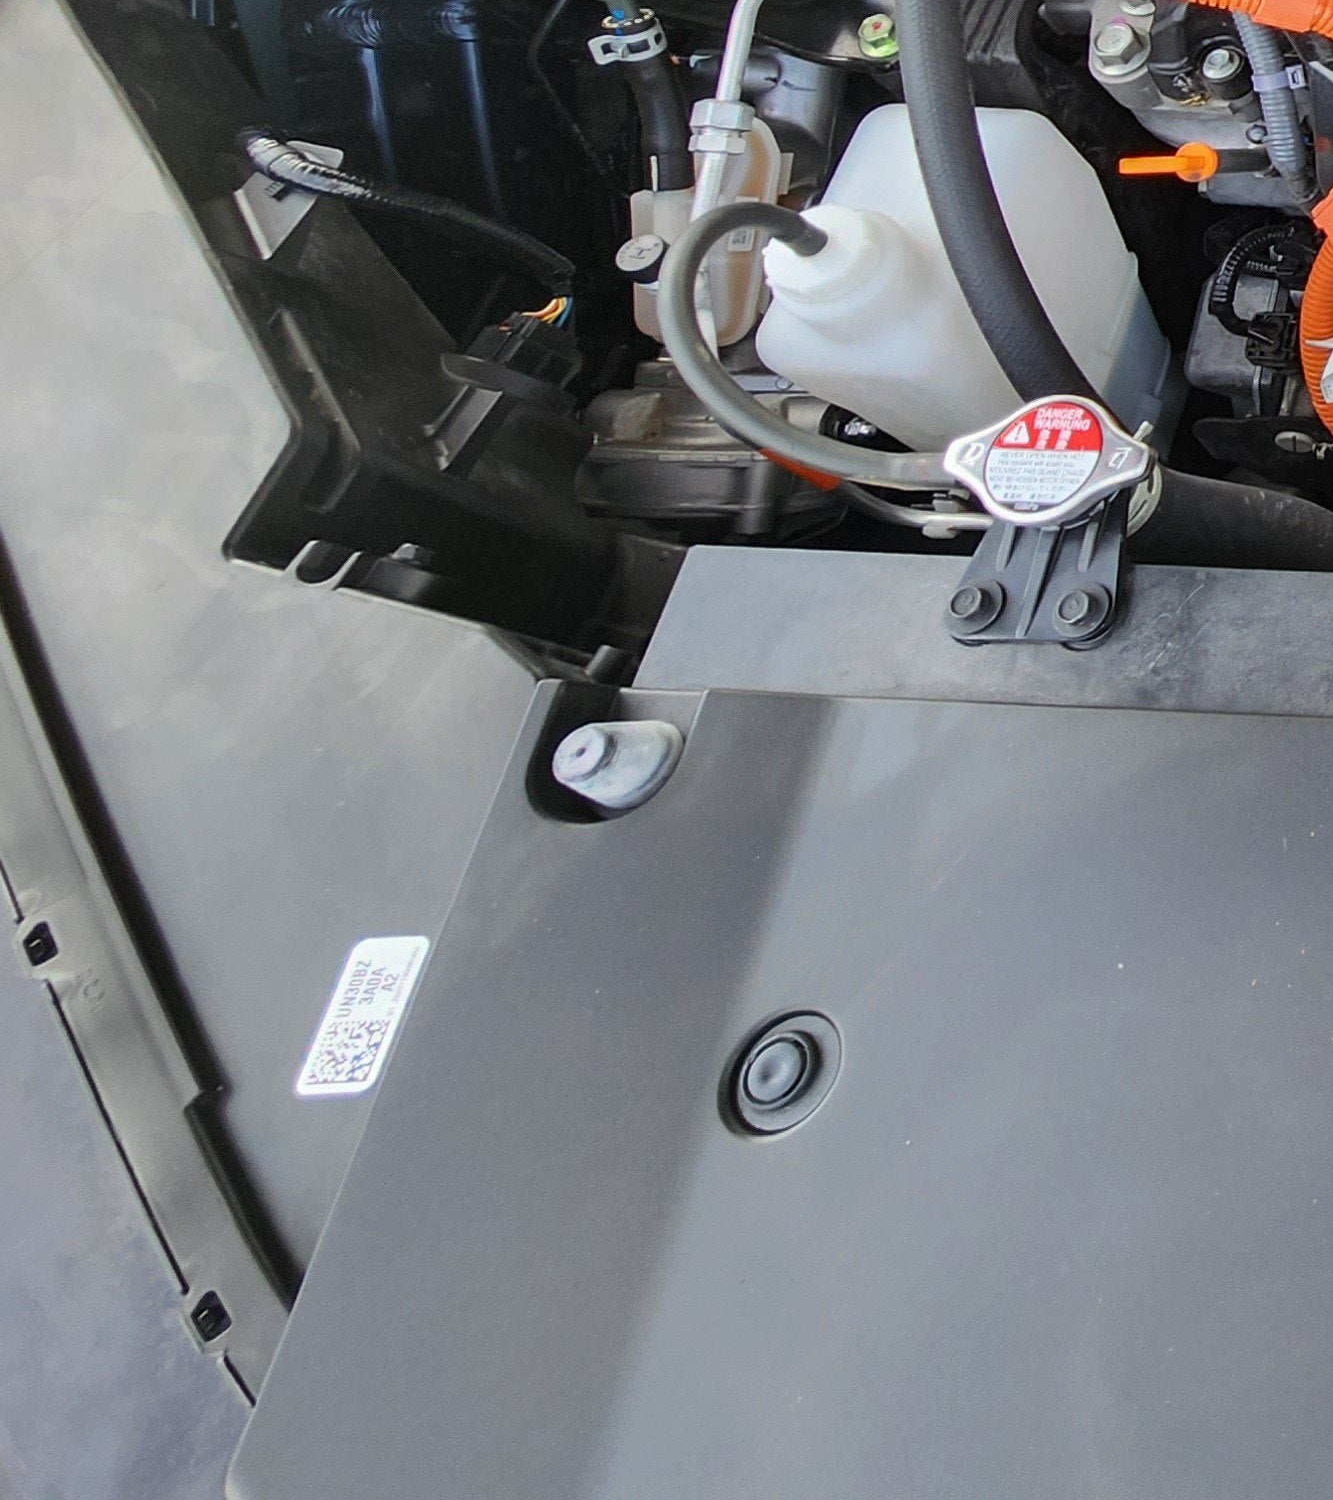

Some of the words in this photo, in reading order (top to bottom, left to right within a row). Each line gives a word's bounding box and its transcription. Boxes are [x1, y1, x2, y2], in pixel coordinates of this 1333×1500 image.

[1037, 409, 1084, 419] DANGER
[1034, 419, 1091, 430] WARNUNG
[382, 974, 399, 991] A2
